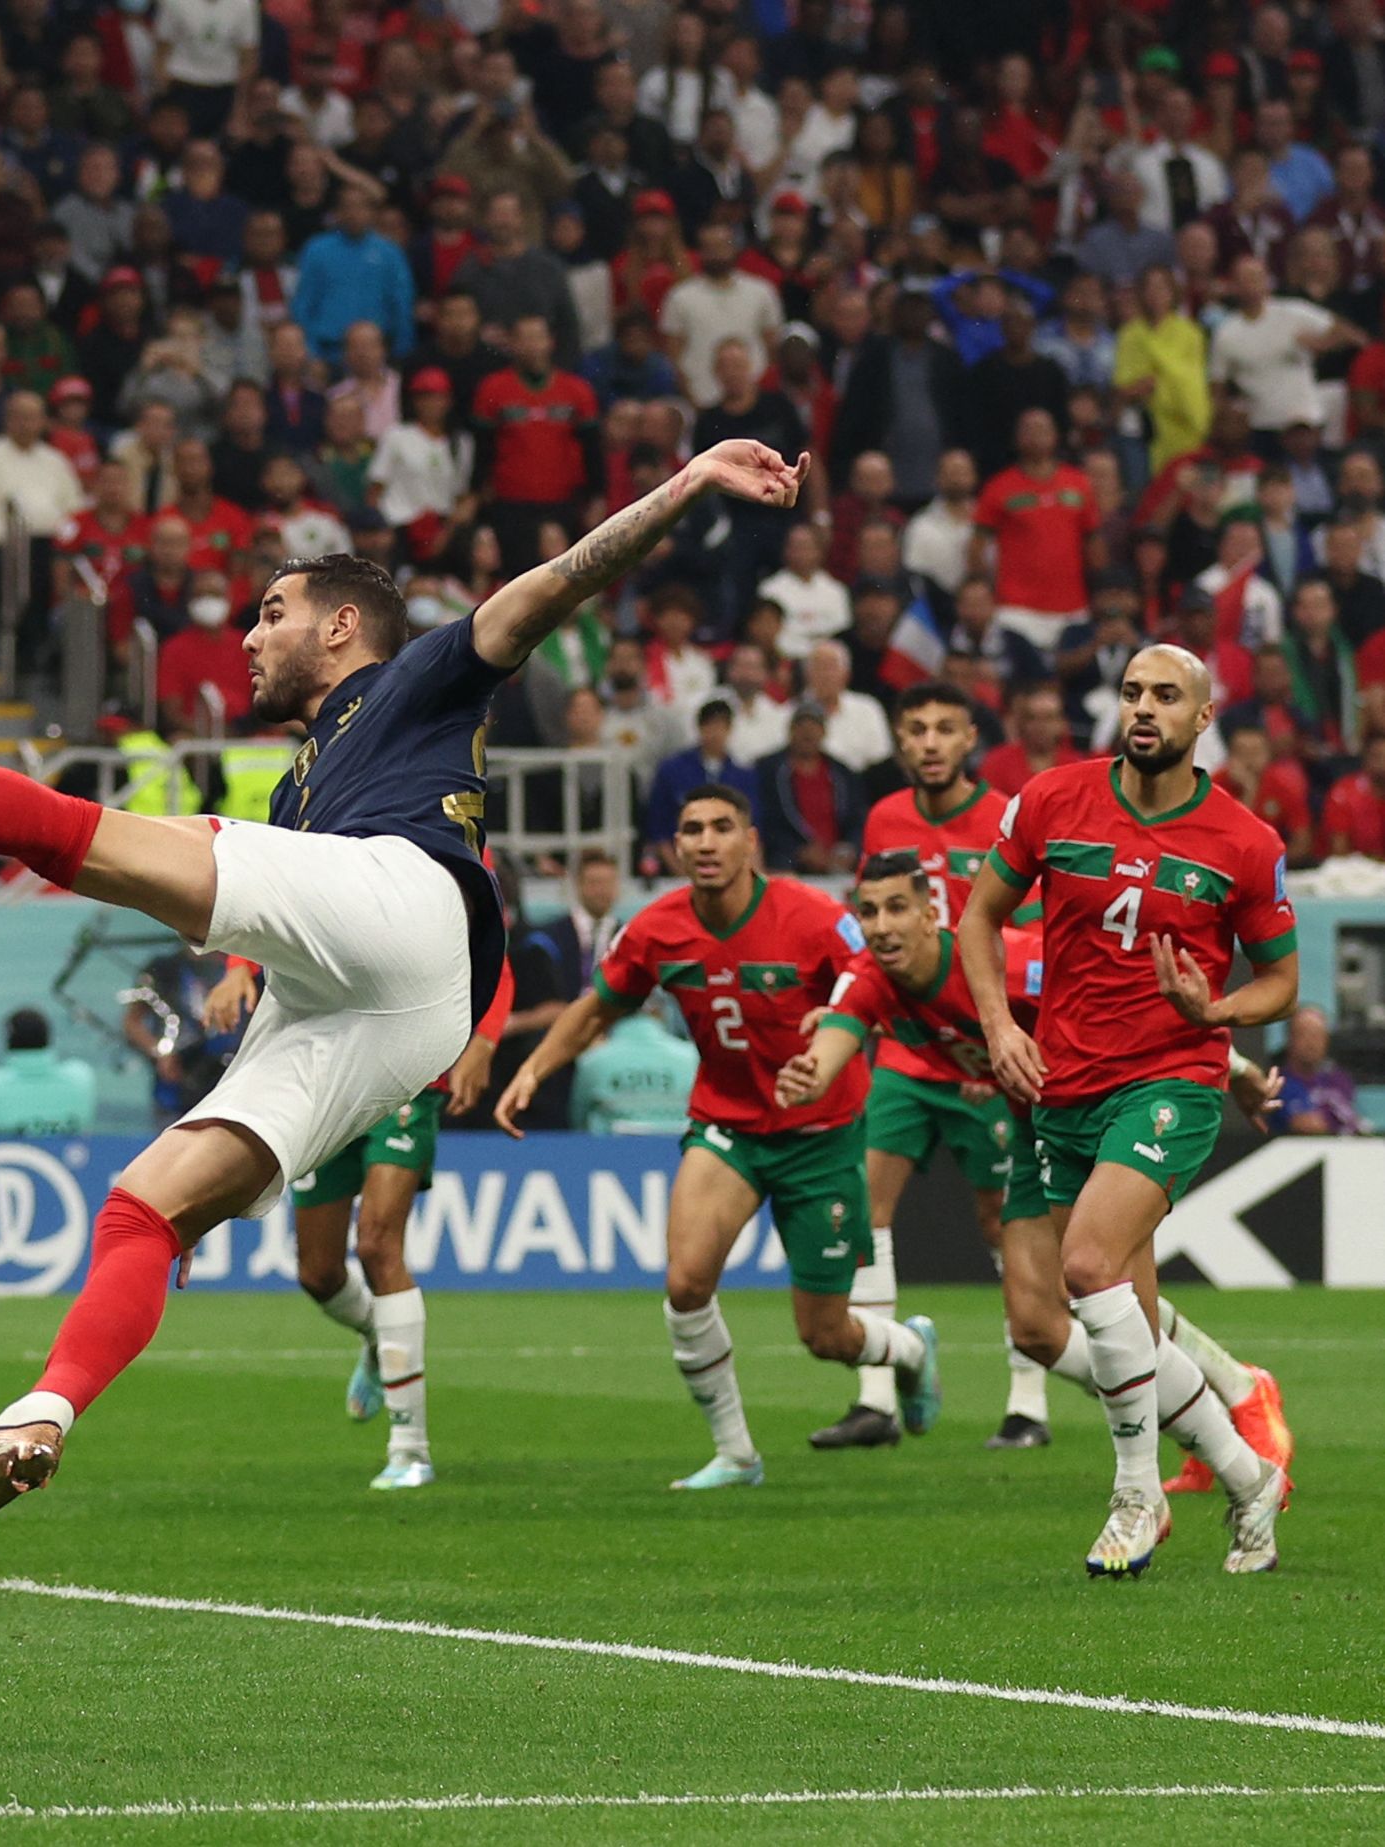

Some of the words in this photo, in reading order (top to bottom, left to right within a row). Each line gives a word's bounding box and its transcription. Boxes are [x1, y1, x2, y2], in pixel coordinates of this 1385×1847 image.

[1102, 886, 1144, 952] 4
[711, 996, 750, 1051] 2
[403, 1170, 788, 1273] WAN
